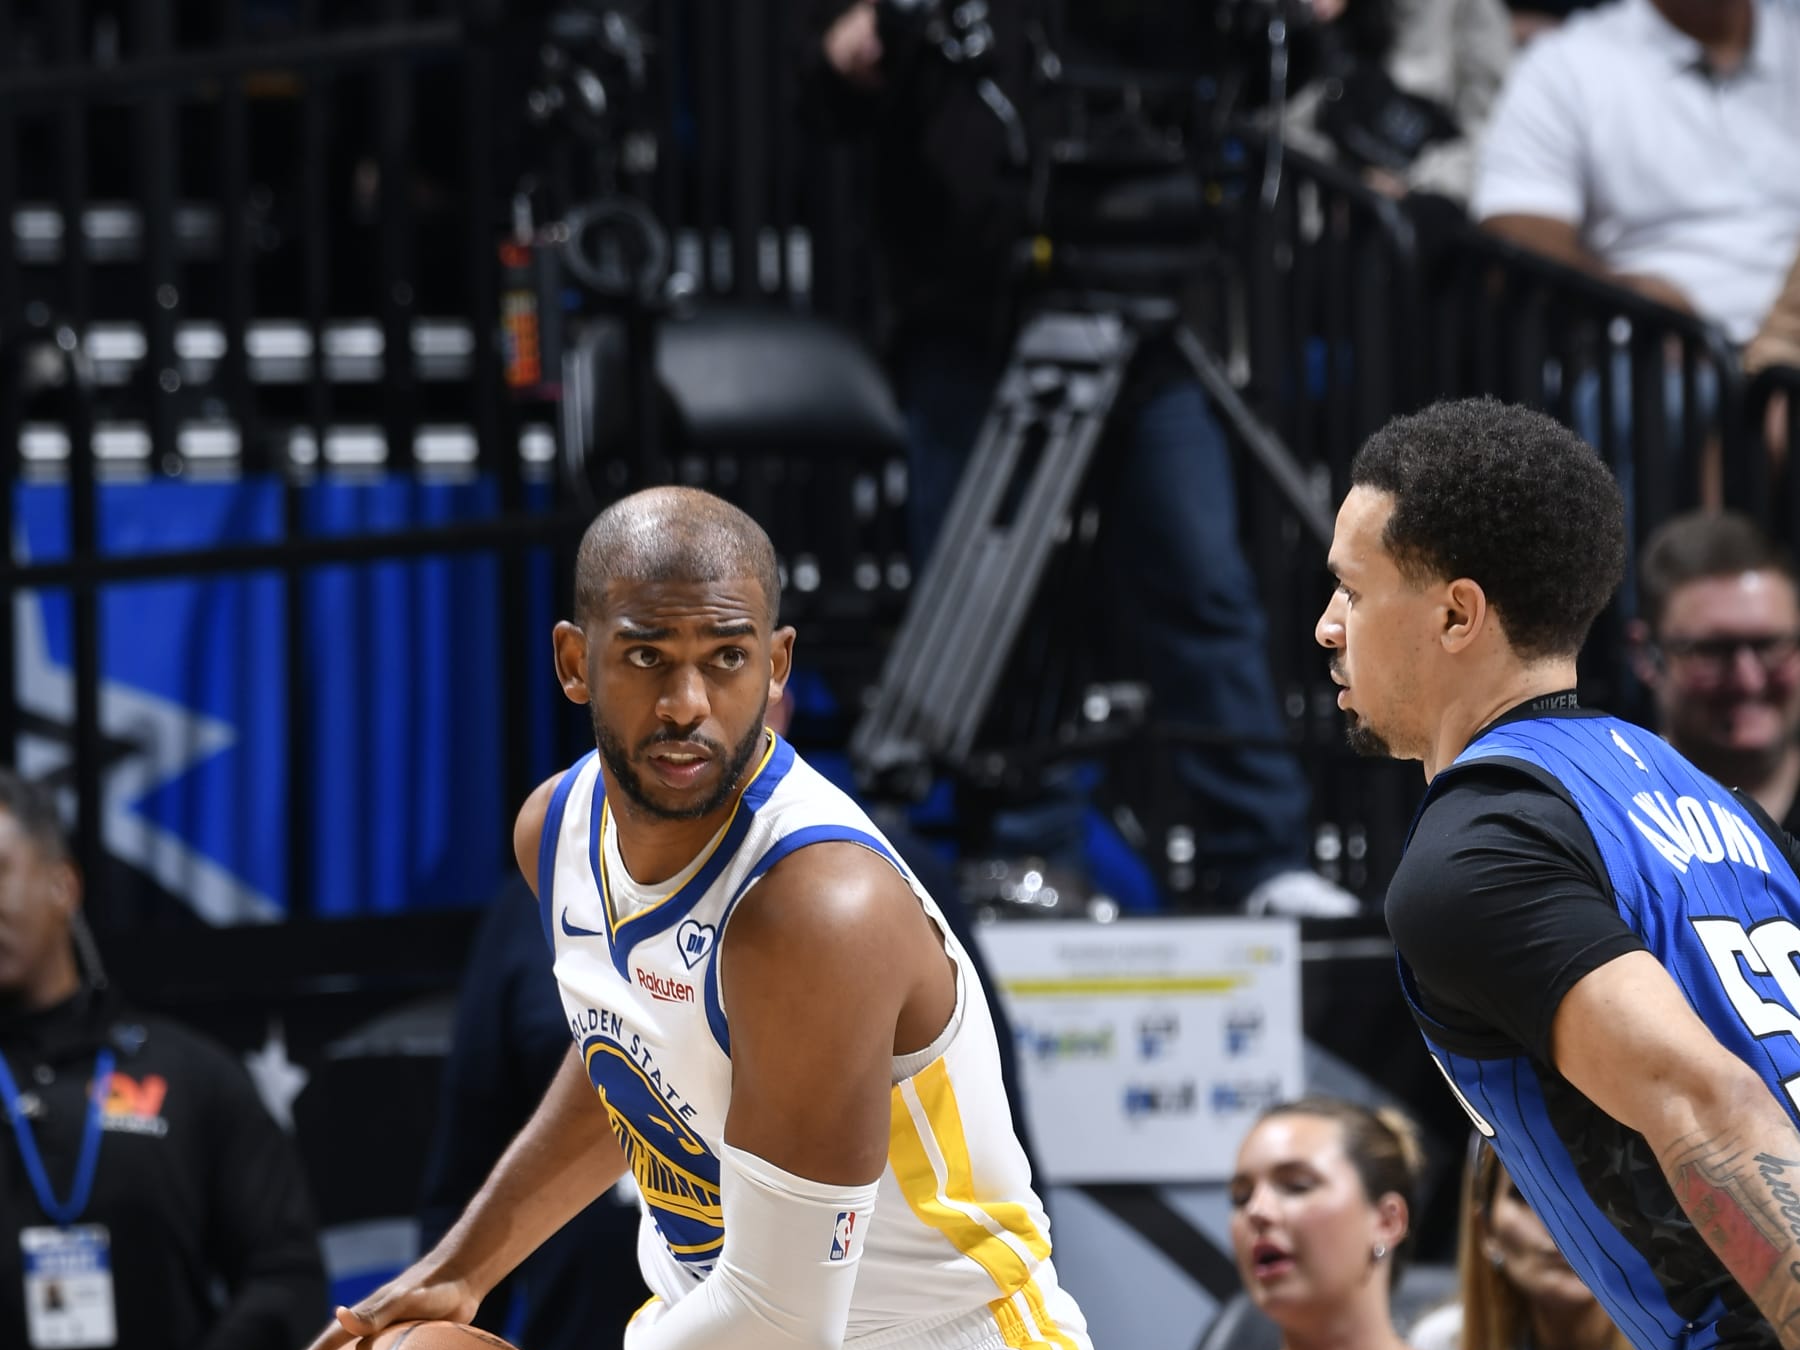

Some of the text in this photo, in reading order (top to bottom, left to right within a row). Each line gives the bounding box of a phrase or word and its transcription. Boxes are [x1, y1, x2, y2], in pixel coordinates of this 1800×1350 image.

[636, 967, 695, 1003] Rakuten
[571, 1008, 698, 1121] OLDEN STATE
